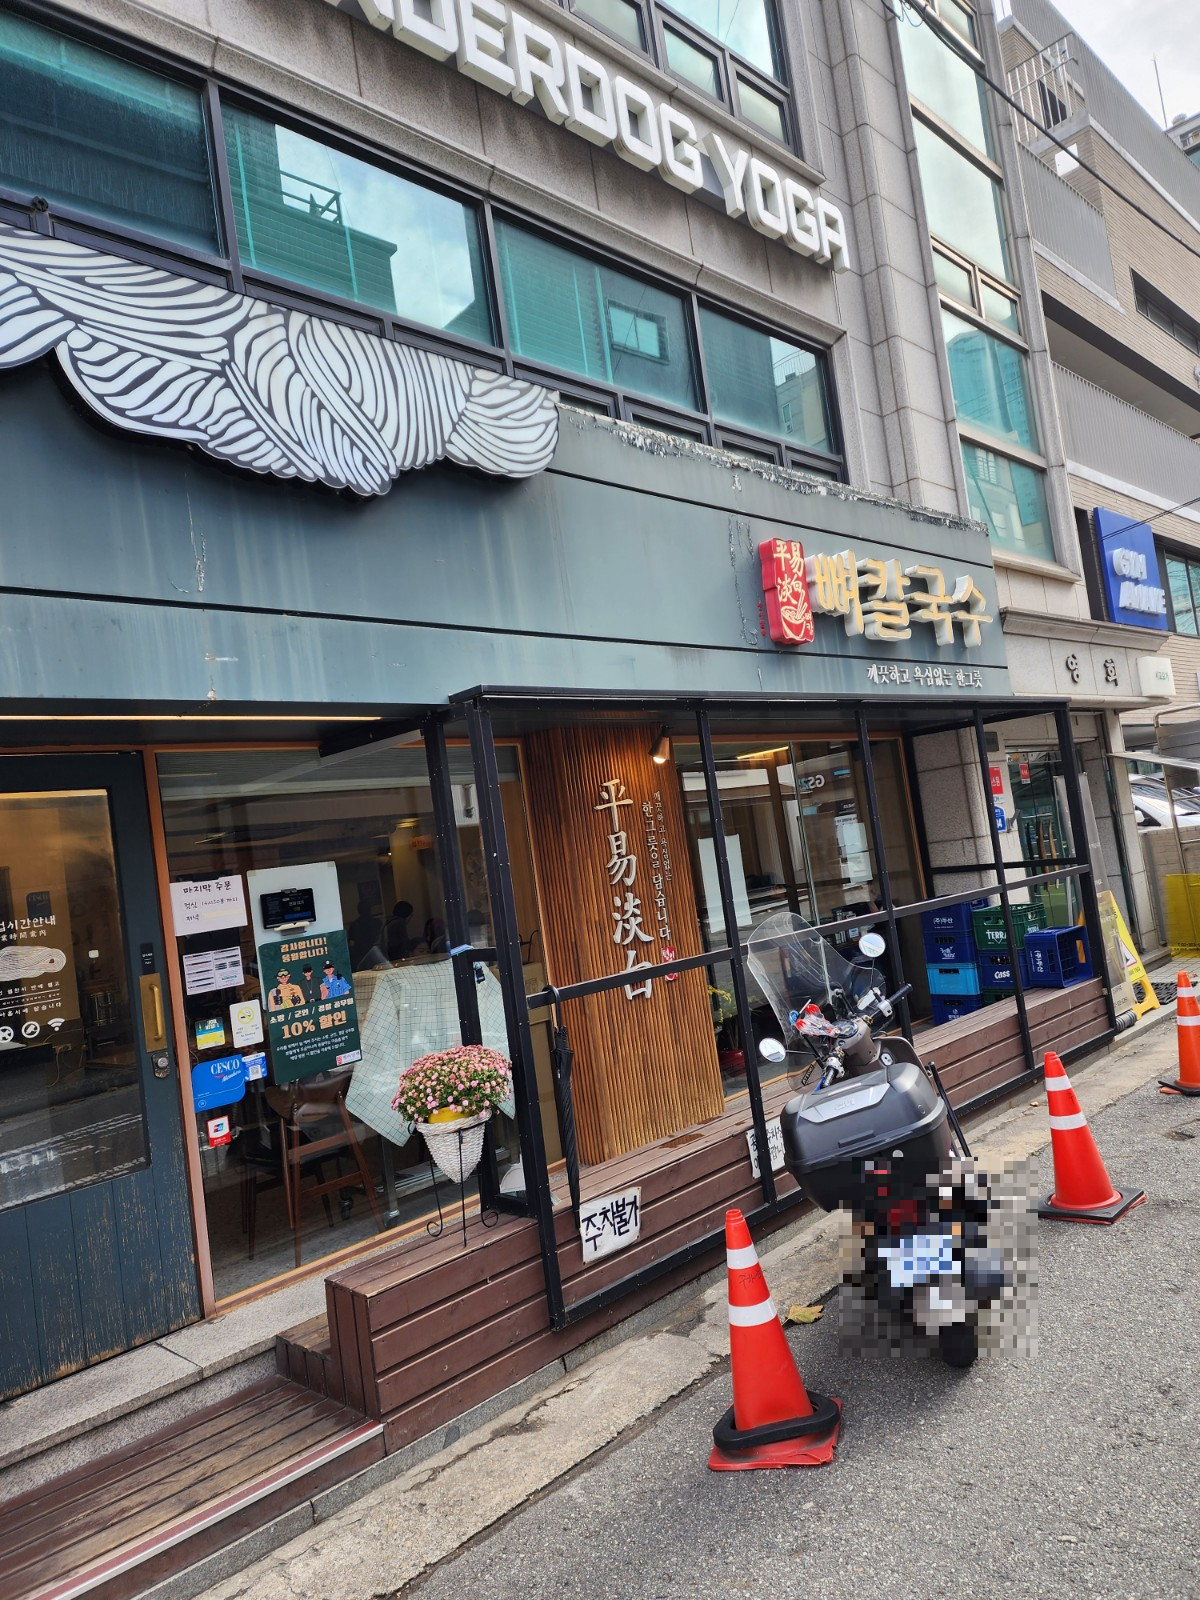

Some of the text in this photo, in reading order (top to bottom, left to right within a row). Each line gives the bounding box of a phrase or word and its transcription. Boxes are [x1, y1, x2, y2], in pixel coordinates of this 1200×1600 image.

[702, 132, 851, 274] YOGA
[807, 549, 993, 648] 뼈칼국수
[867, 664, 983, 688] 깨끗하고 욕심없는 한그릇
[642, 802, 671, 941] 한그릇을 담습니다
[183, 880, 232, 894] 마지막 주문
[280, 937, 327, 953] 감사합니다!
[281, 947, 329, 963] 응원합니다!
[281, 1019, 315, 1039] 10%
[319, 1010, 347, 1029] 할인
[210, 1058, 240, 1075] CESCO
[581, 1195, 639, 1251] 주차불가
